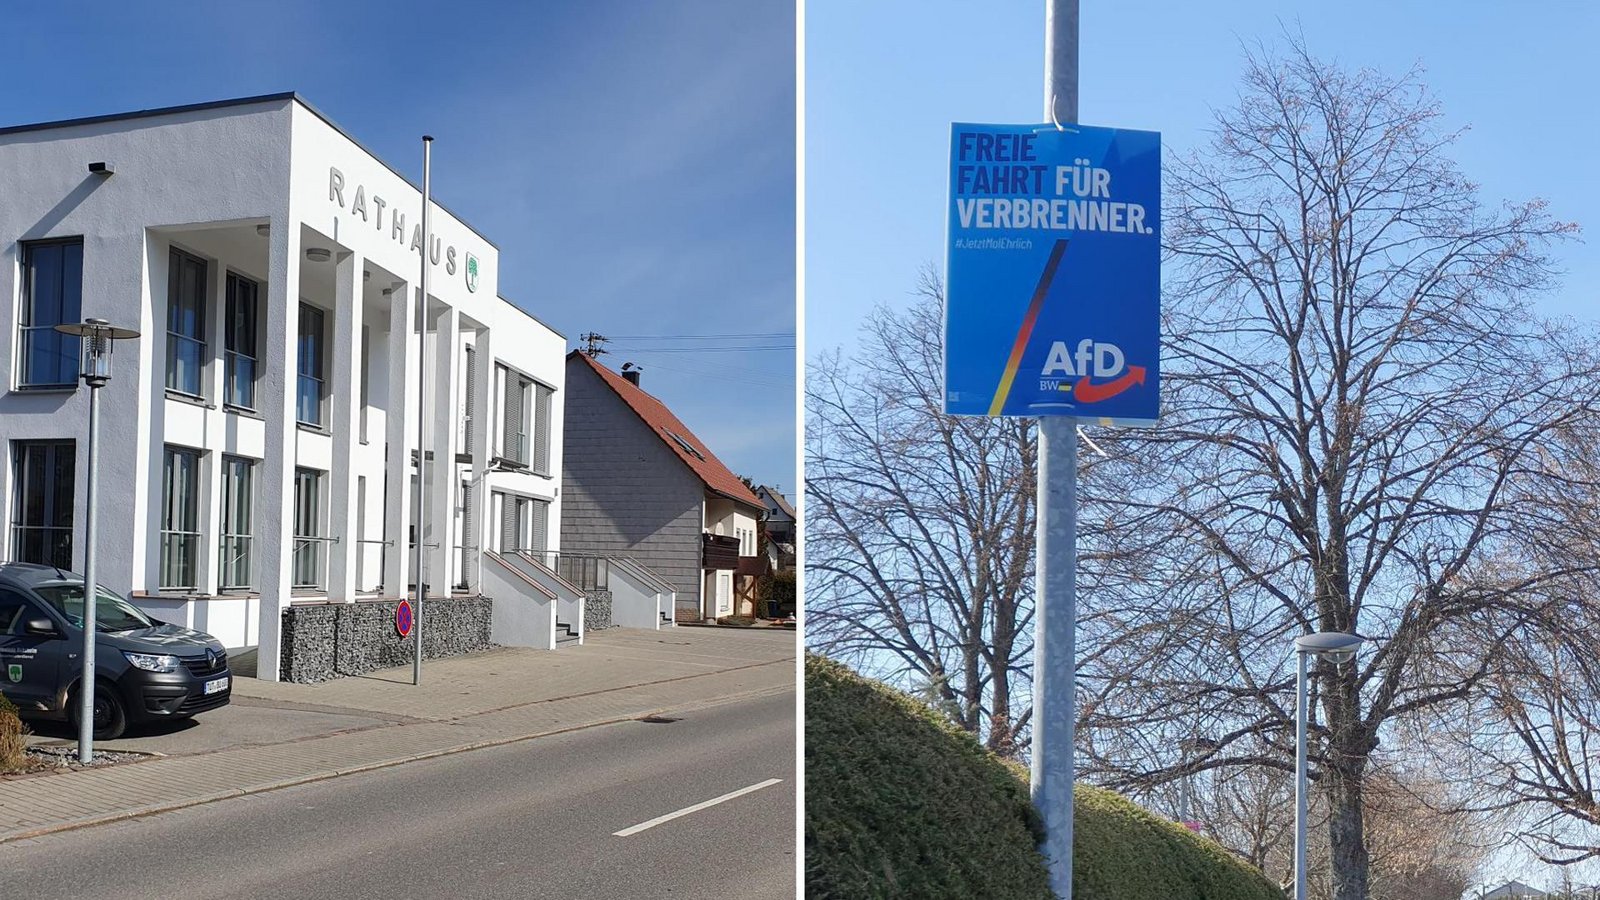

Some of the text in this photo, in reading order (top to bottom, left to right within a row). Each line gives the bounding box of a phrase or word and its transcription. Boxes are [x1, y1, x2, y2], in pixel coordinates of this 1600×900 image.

[958, 132, 1037, 162] FREIE
[957, 157, 1111, 198] FAHRT FÜR
[329, 166, 457, 276] RATHAUS
[956, 198, 1153, 235] VERBRENNER.
[1041, 338, 1125, 377] AfD
[1040, 380, 1059, 391] BW
